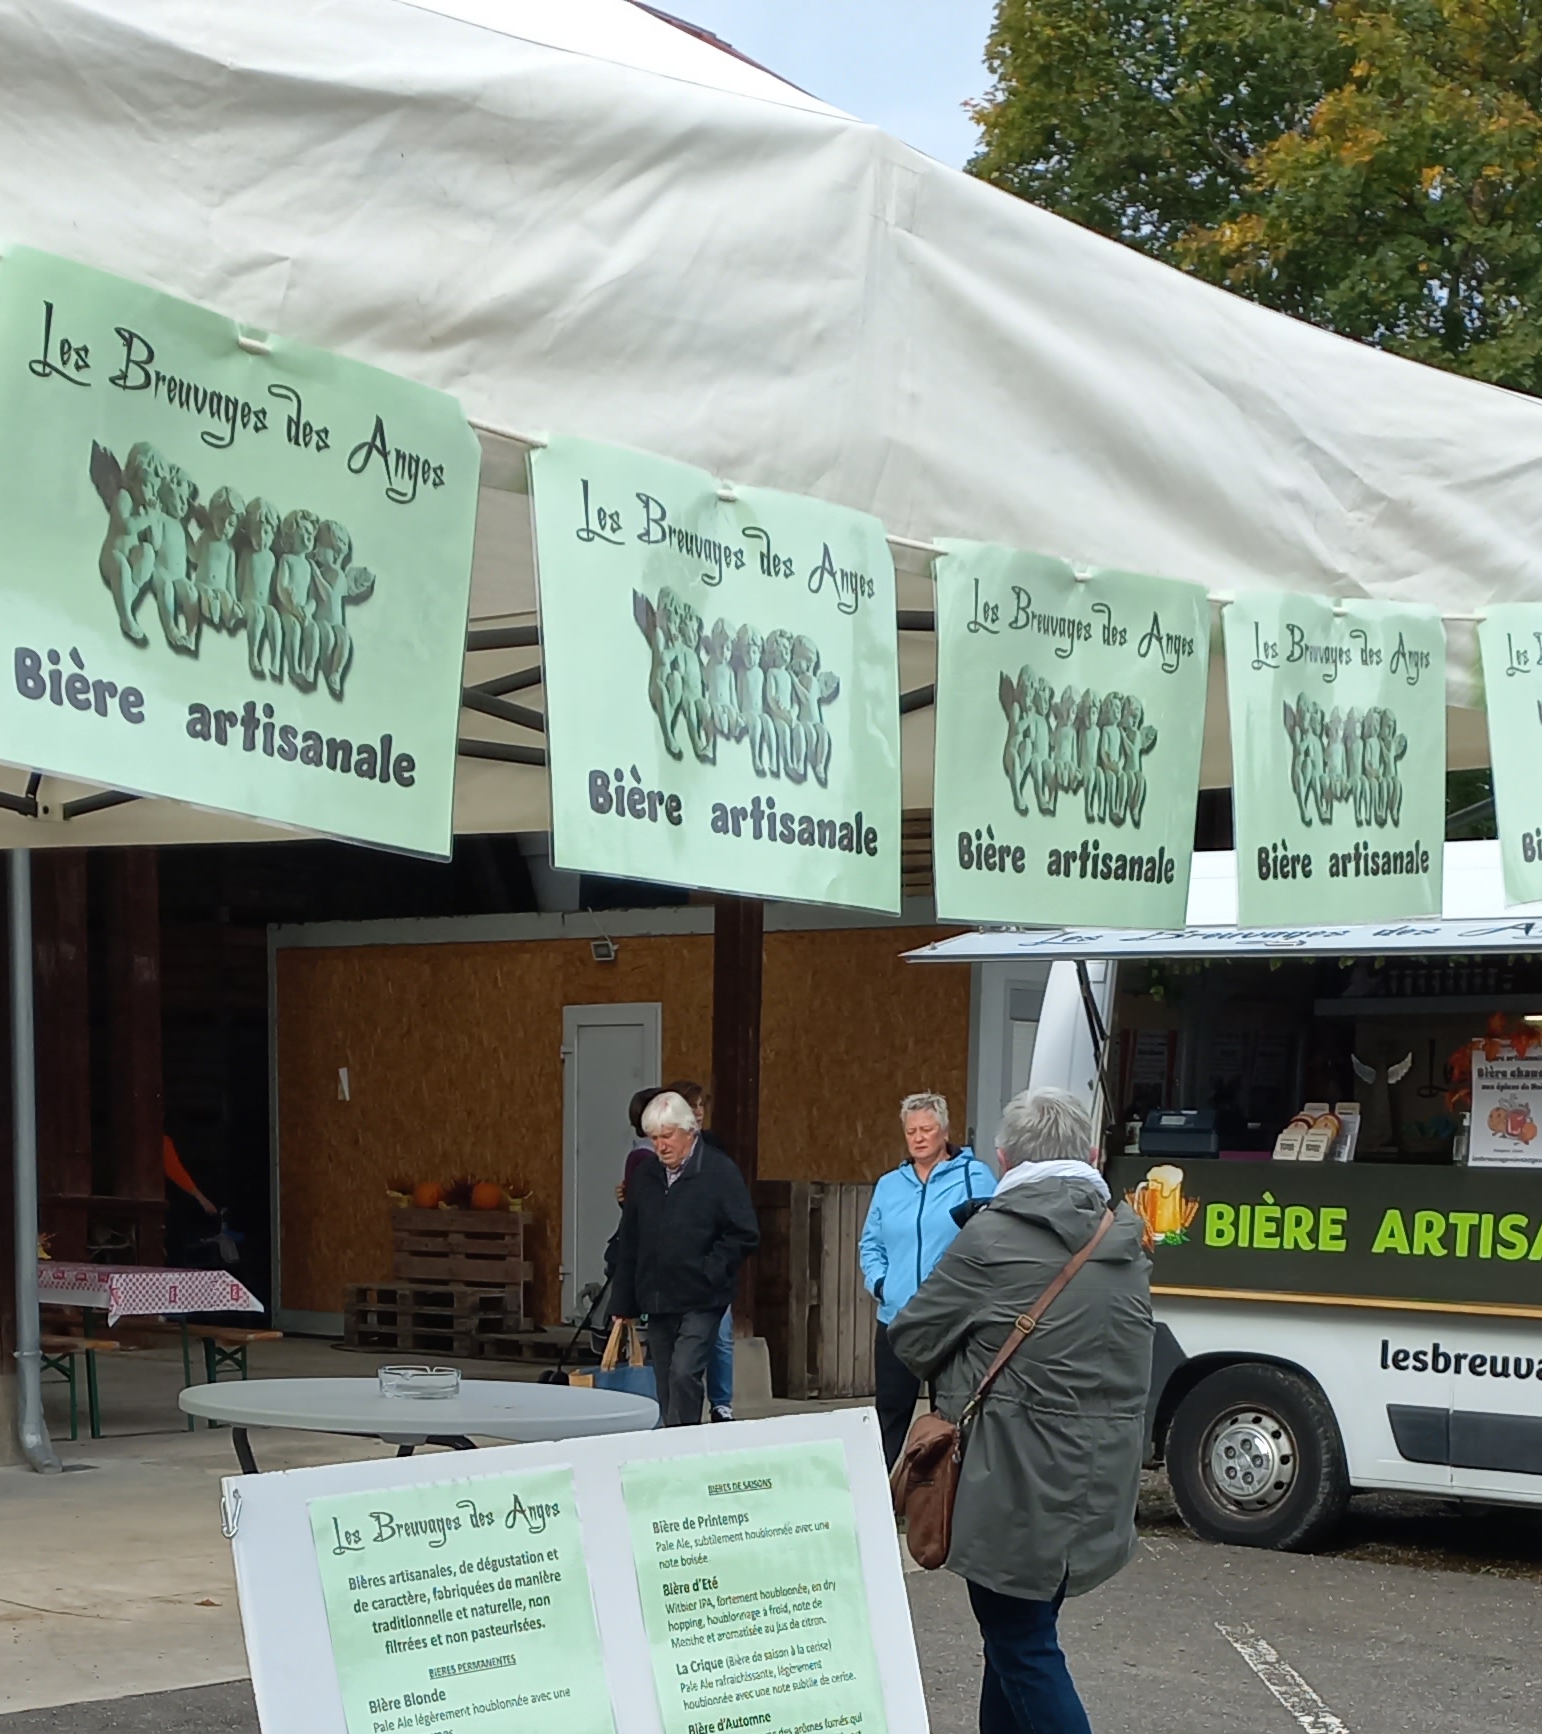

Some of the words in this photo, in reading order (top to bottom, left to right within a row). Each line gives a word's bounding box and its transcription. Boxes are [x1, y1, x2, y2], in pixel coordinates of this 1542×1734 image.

[28, 299, 90, 388] Les
[109, 325, 267, 450] Breuvages
[267, 384, 331, 452] des
[347, 416, 446, 505] Anges
[576, 478, 624, 546] Les
[635, 492, 746, 588] Breuvages
[742, 527, 794, 581] des
[808, 542, 875, 614] Anges
[13, 645, 146, 725] Bière
[186, 700, 416, 788] artisanale
[588, 769, 683, 827] Bière
[710, 794, 878, 856] artisanale
[958, 824, 1026, 876] Bière
[1047, 836, 1175, 885] artisanale
[1258, 838, 1313, 881] Bière
[1328, 838, 1430, 878] artisanale
[1204, 1191, 1347, 1252] BIÈRE
[653, 1519, 680, 1534] Bière
[683, 1518, 696, 1530] de
[698, 1511, 749, 1529] Printemps
[349, 1574, 386, 1591] Bières
[389, 1562, 456, 1585] artisanales,
[459, 1560, 474, 1574] de
[477, 1550, 544, 1572] dégustation
[547, 1549, 559, 1561] et
[369, 1696, 401, 1715] Bière
[404, 1688, 446, 1707] Blonde
